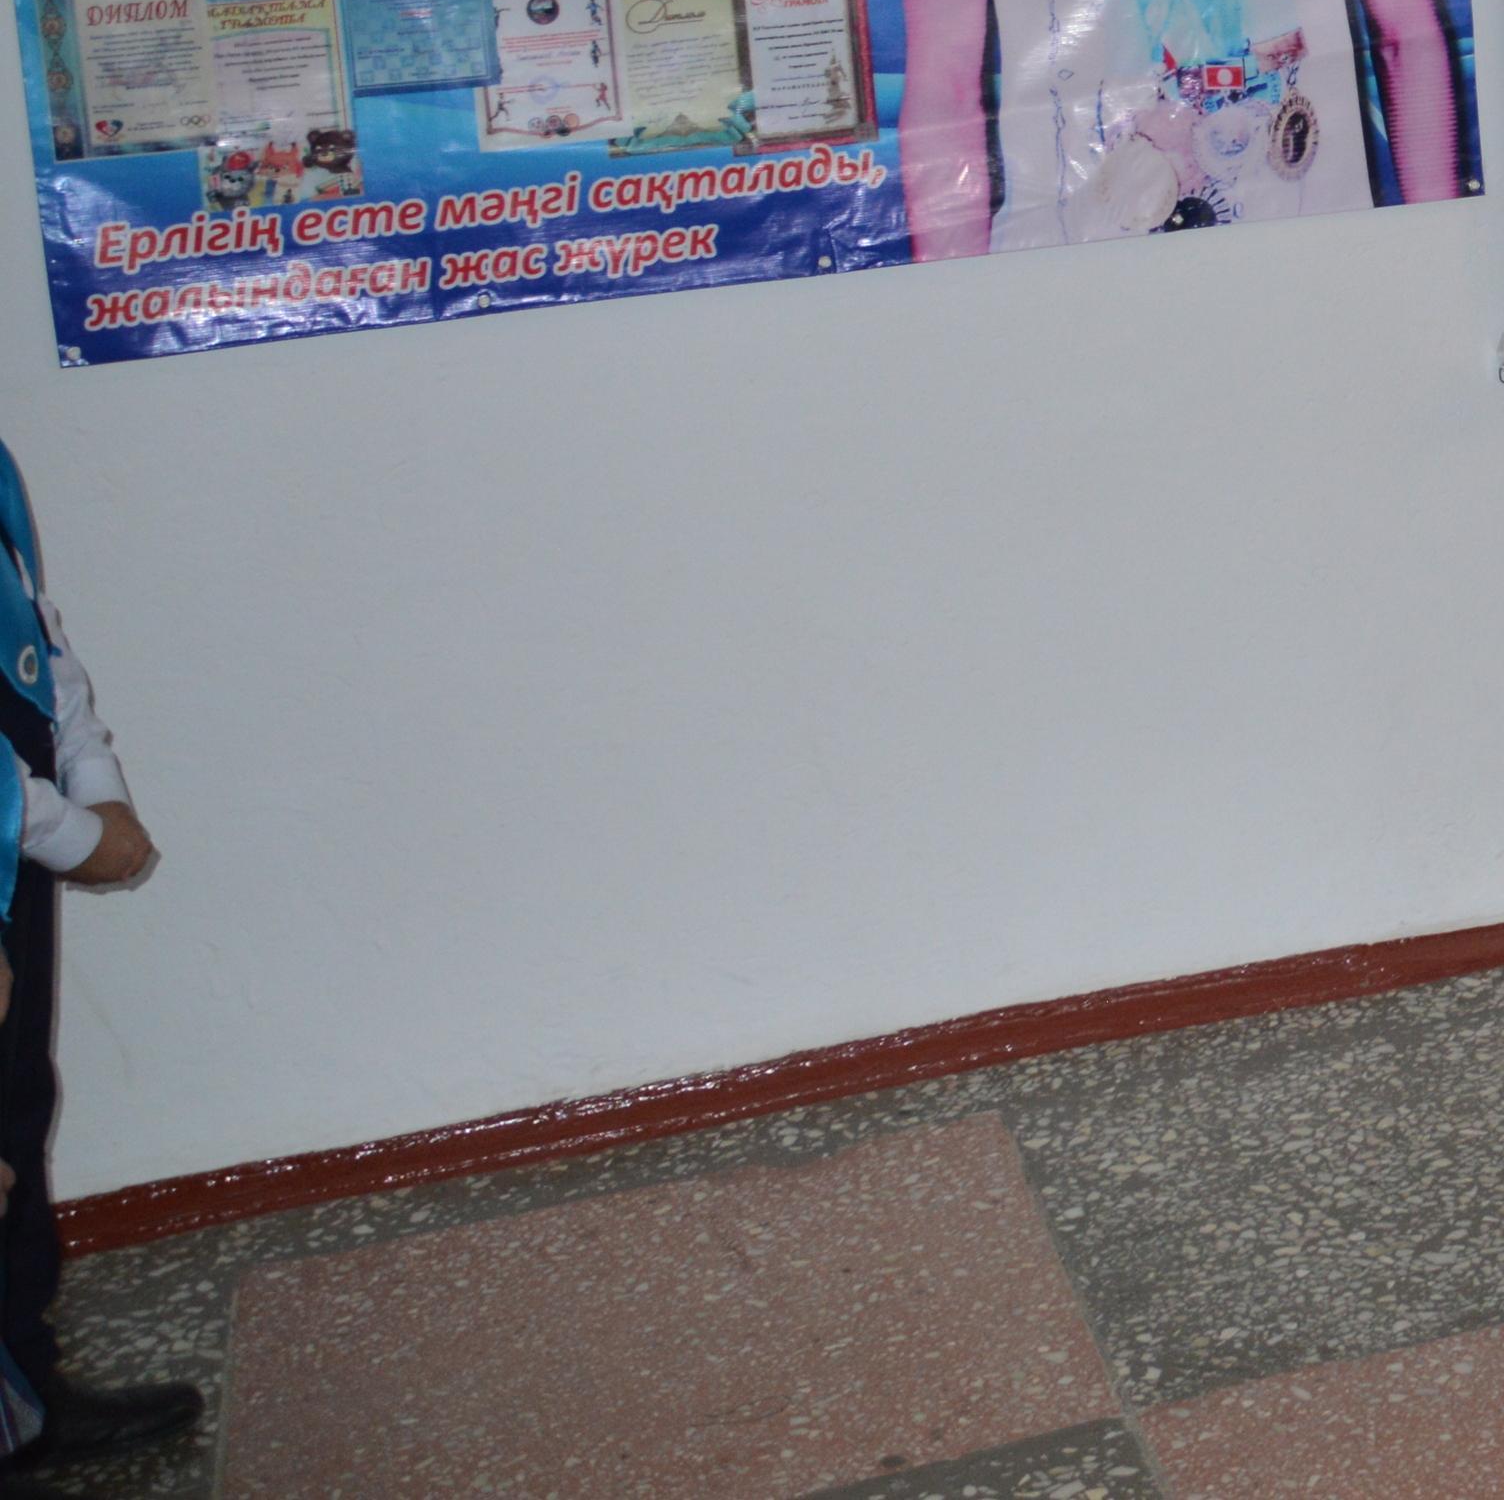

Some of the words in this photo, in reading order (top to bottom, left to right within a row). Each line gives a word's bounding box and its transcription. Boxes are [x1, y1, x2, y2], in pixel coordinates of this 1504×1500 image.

[99, 211, 281, 270] Ерлігің
[296, 202, 425, 242] есте
[438, 174, 579, 226] мәңгі
[88, 262, 429, 328] жалындаған
[444, 246, 544, 286] жас
[558, 227, 717, 274] жүрек
